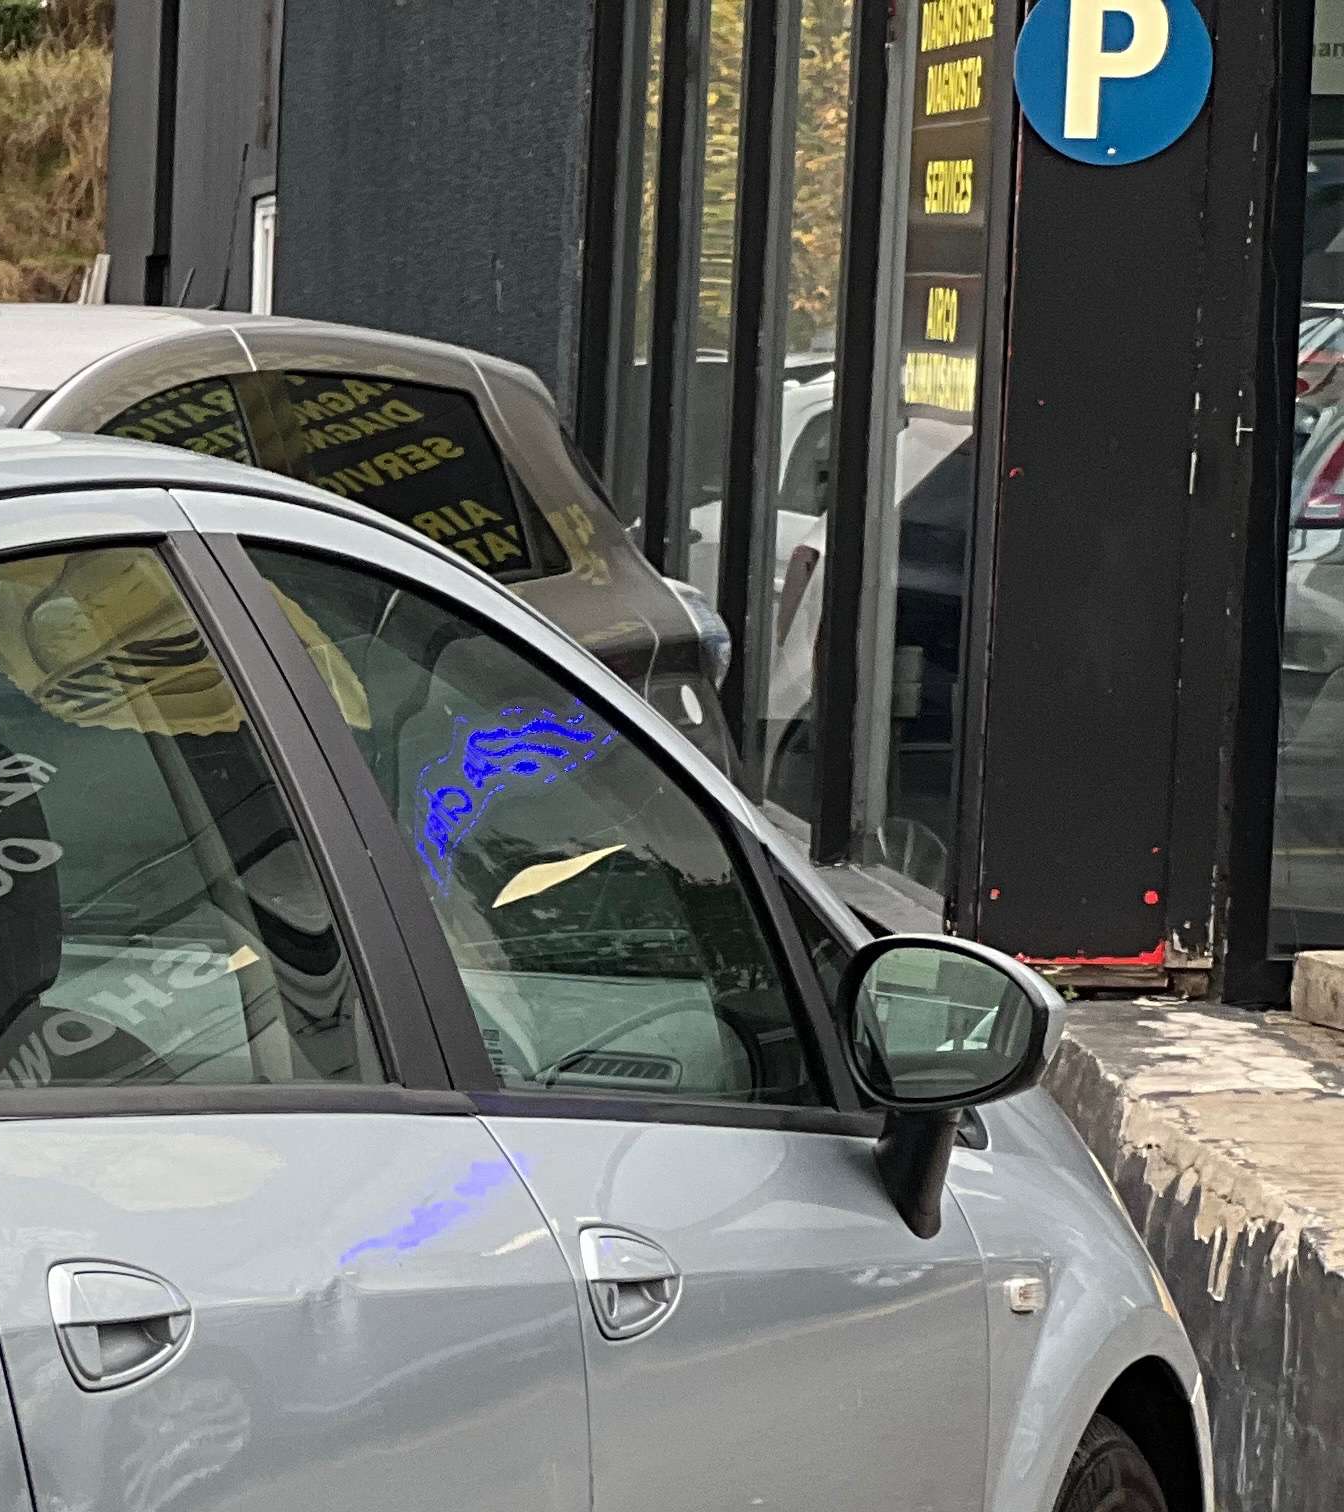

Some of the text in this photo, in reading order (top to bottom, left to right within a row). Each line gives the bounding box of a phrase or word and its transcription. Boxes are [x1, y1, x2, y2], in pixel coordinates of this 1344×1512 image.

[926, 56, 982, 115] DIAGNOSTIC
[1064, 0, 1169, 139] P
[925, 159, 973, 214] SERVICES
[925, 287, 958, 342] AIRCO
